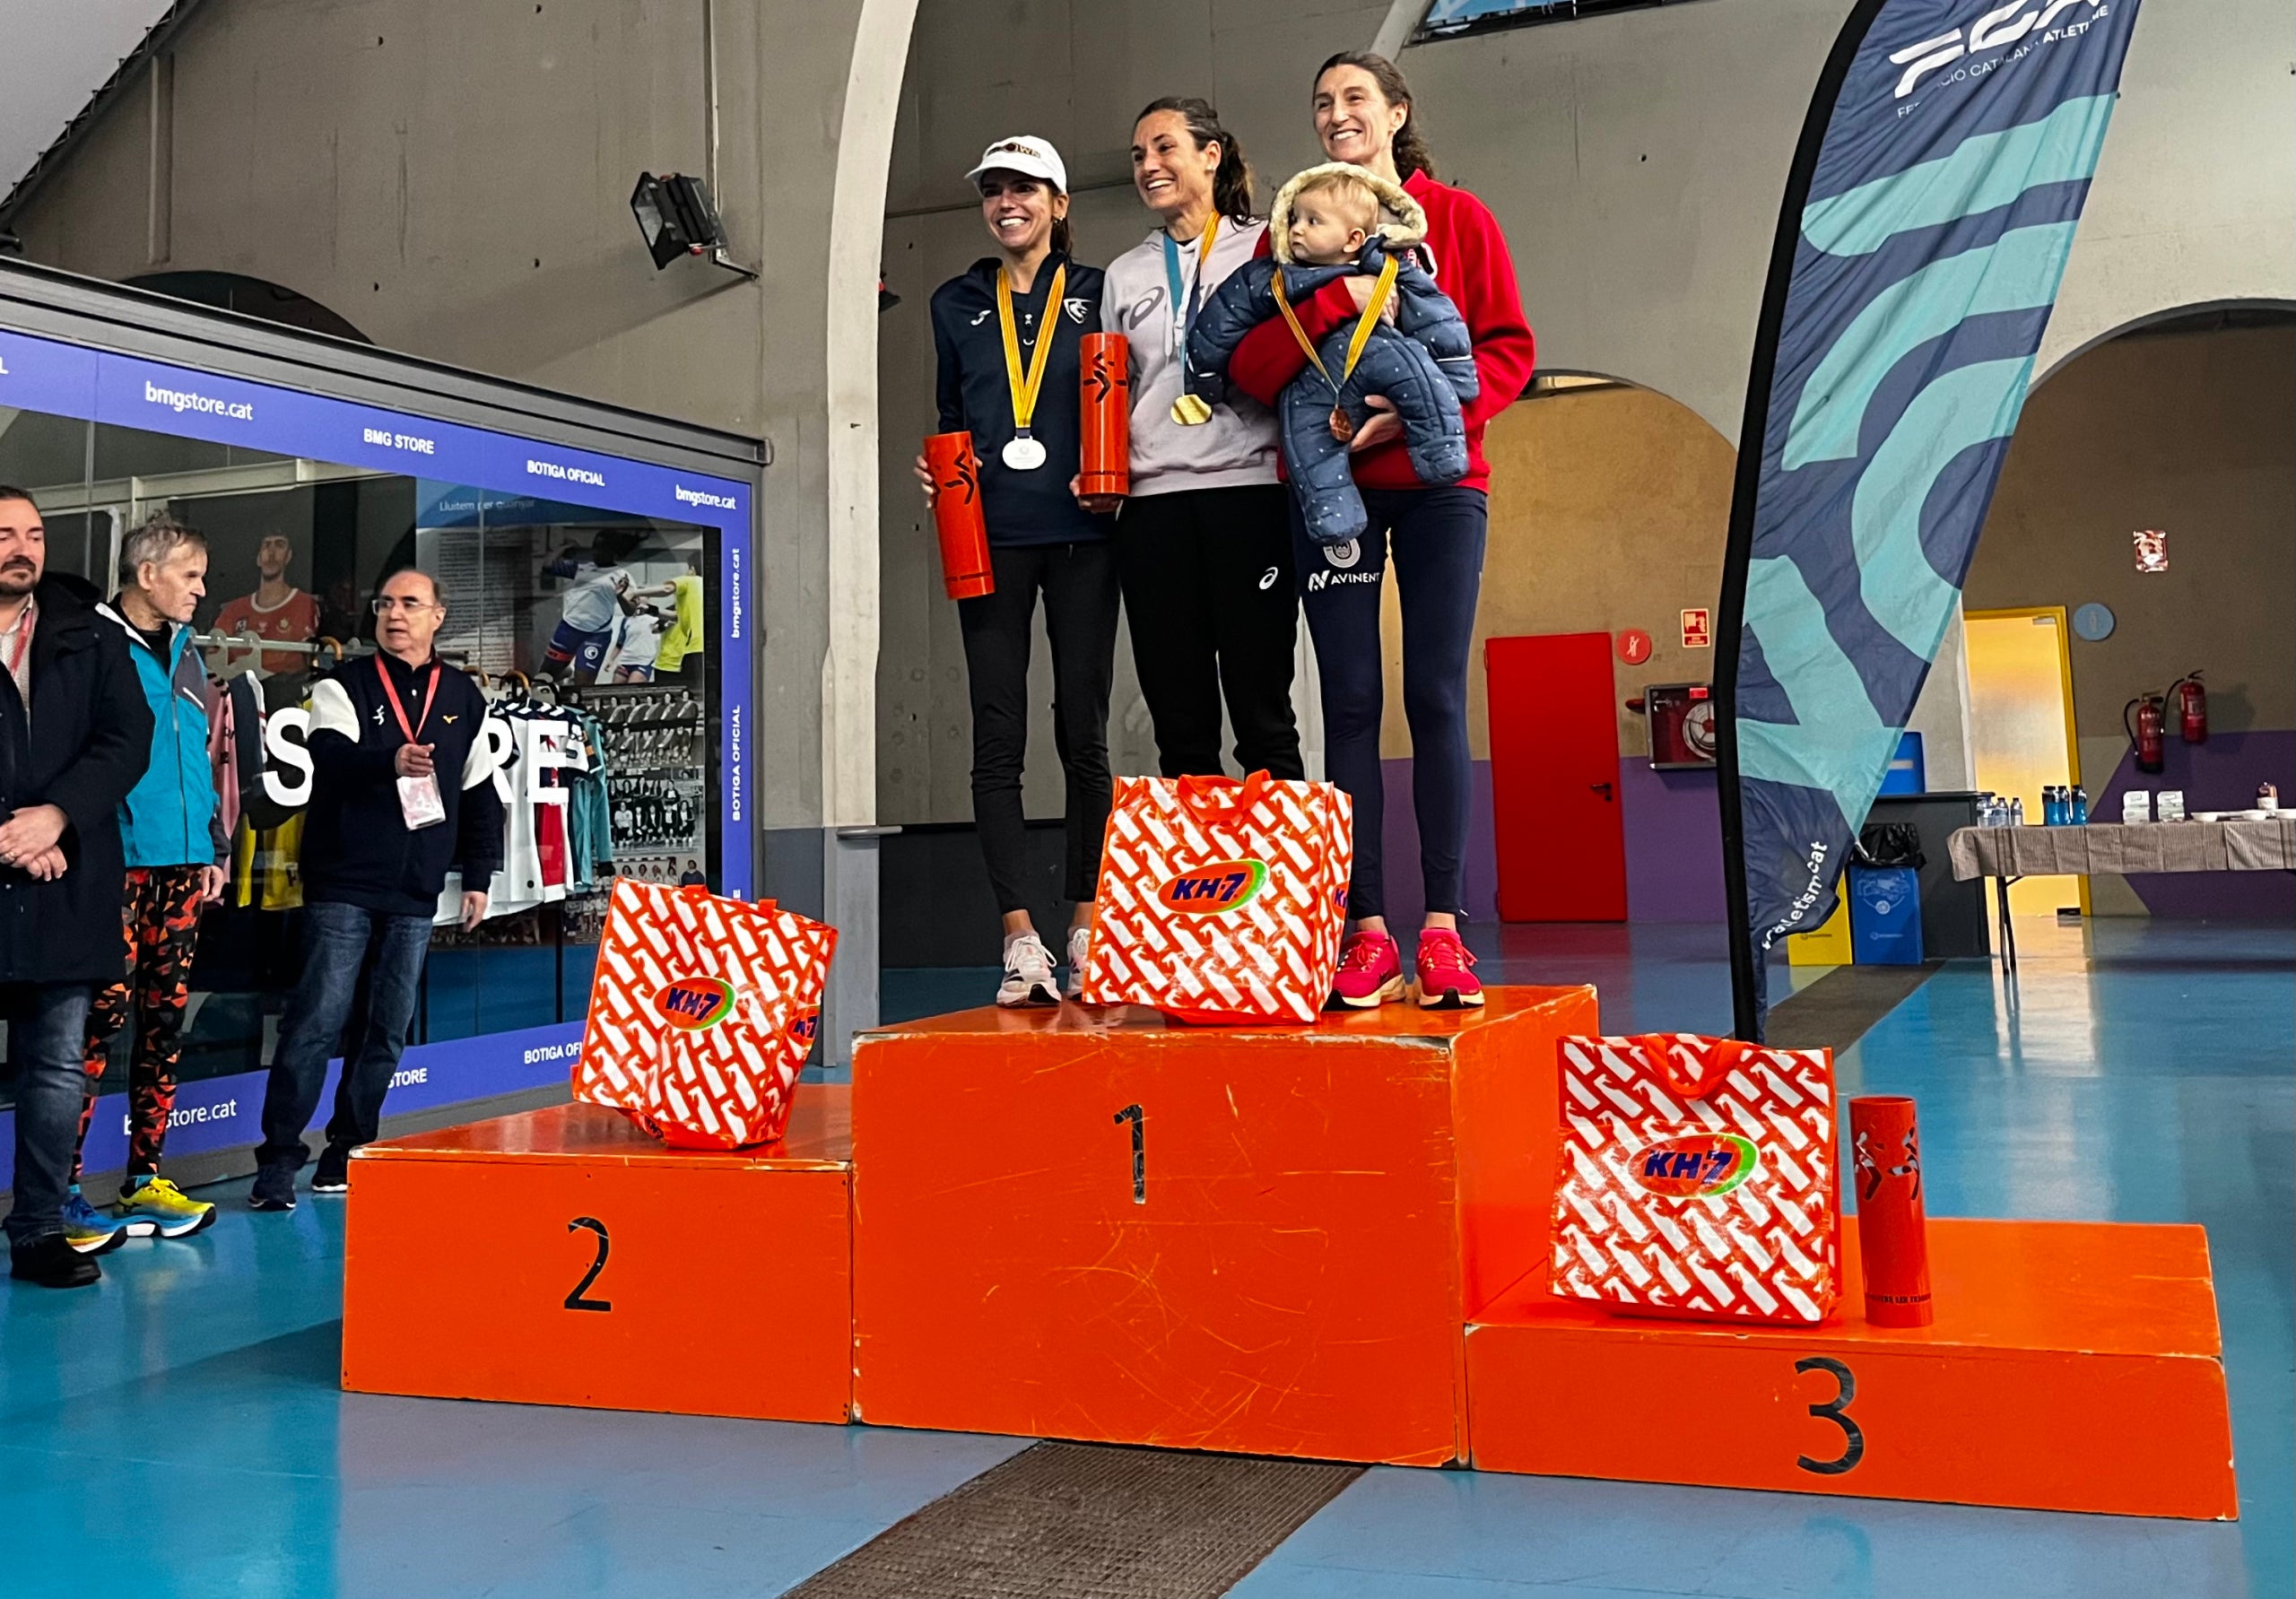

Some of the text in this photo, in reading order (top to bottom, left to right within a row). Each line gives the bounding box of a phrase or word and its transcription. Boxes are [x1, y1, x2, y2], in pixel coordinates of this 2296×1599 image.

[144, 380, 254, 421] bmgstore.cat
[363, 428, 435, 455] BMG STORE
[526, 459, 606, 487] BOTIGA OFICIAL
[675, 483, 736, 510] bmgstore.cat
[731, 548, 743, 639] bmgstore.cat
[1330, 572, 1380, 586] AVINENT
[732, 704, 741, 821] BOTIGA OFICIAL
[524, 1045, 565, 1065] BOTIGA
[1113, 1103, 1145, 1204] 1
[564, 1216, 612, 1312] 2
[1795, 1357, 1864, 1475] 3
